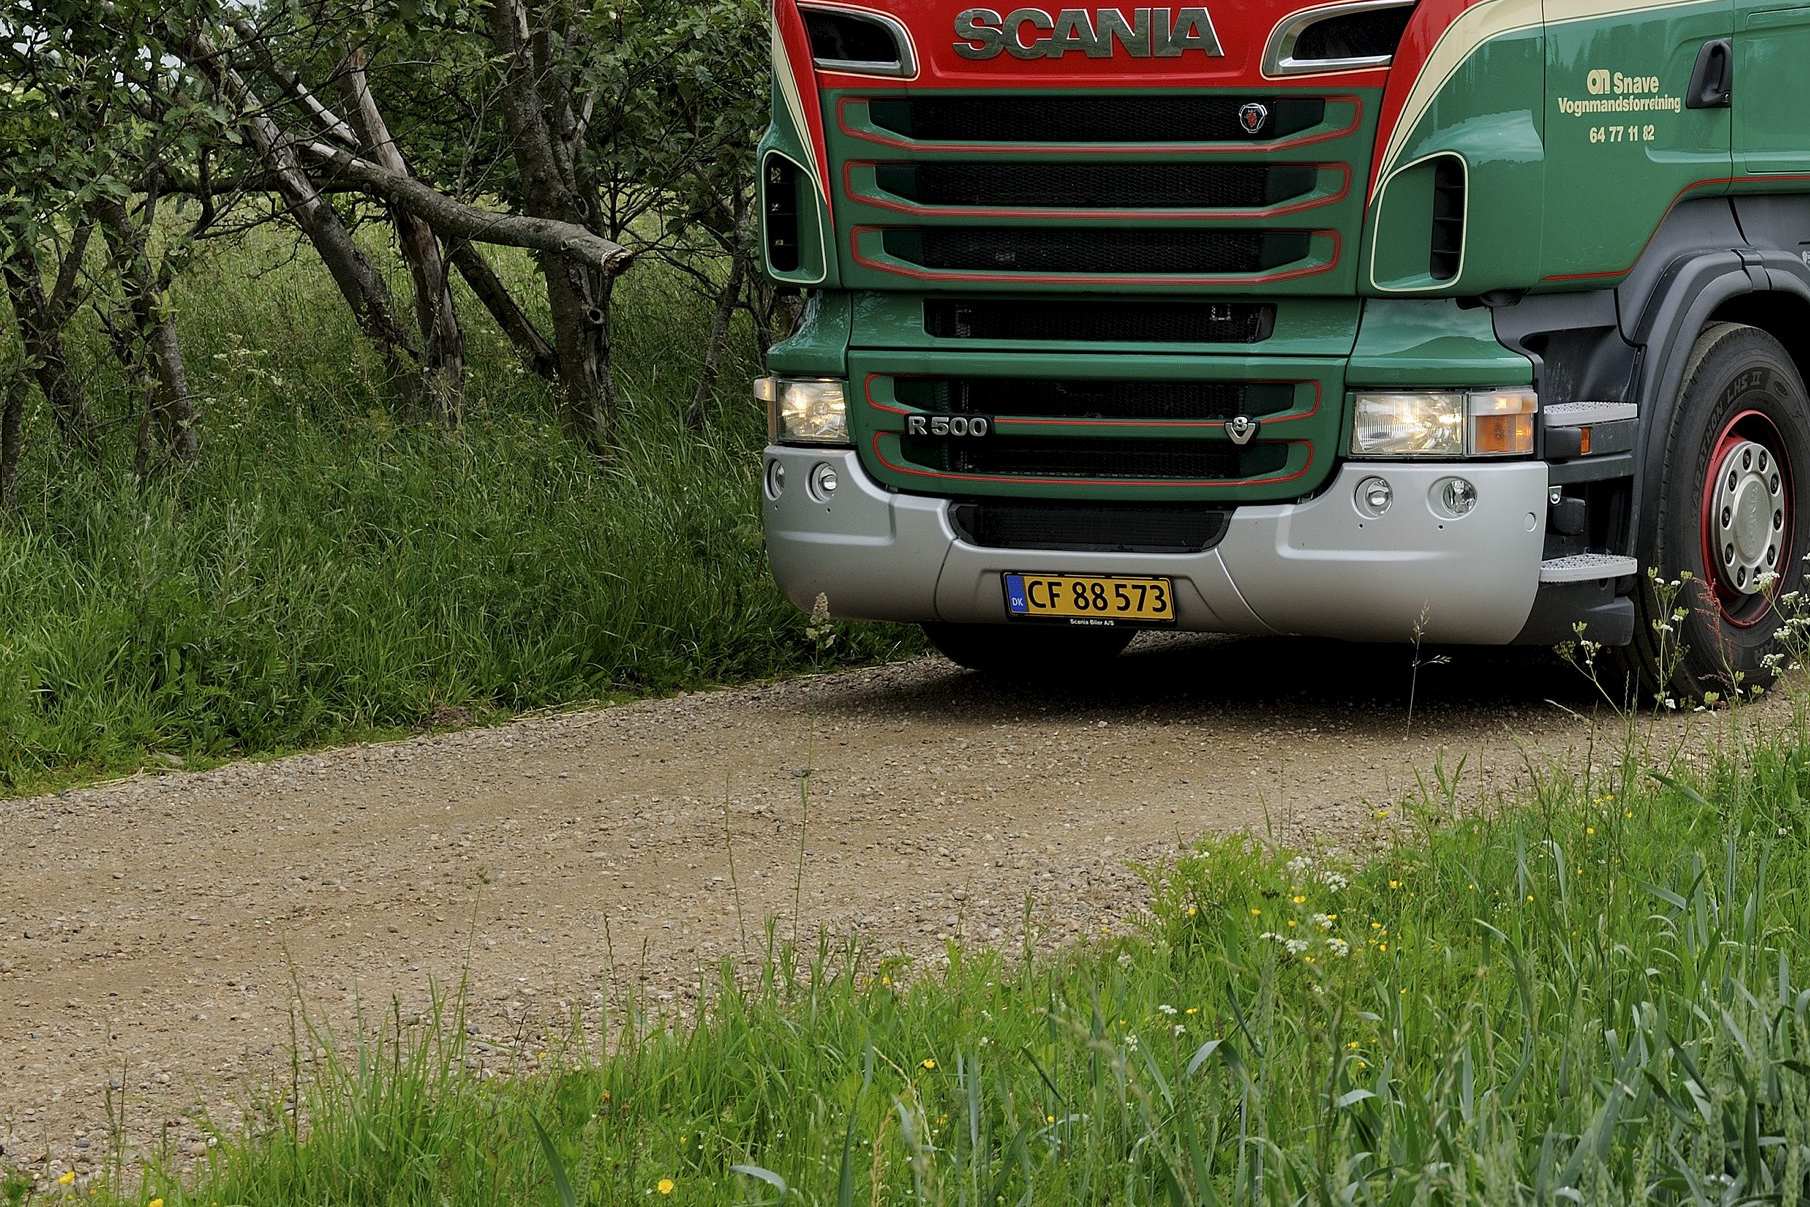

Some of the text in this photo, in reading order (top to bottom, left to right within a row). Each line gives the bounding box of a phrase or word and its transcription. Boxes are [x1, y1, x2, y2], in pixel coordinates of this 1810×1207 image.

[952, 7, 1225, 60] SCANIA
[1613, 71, 1659, 95] Snave
[1557, 93, 1681, 117] Vognmandsforretning
[1589, 124, 1655, 143] 64 77 11 82
[907, 415, 988, 437] R 500
[1011, 579, 1167, 613] DK CF 88 573
